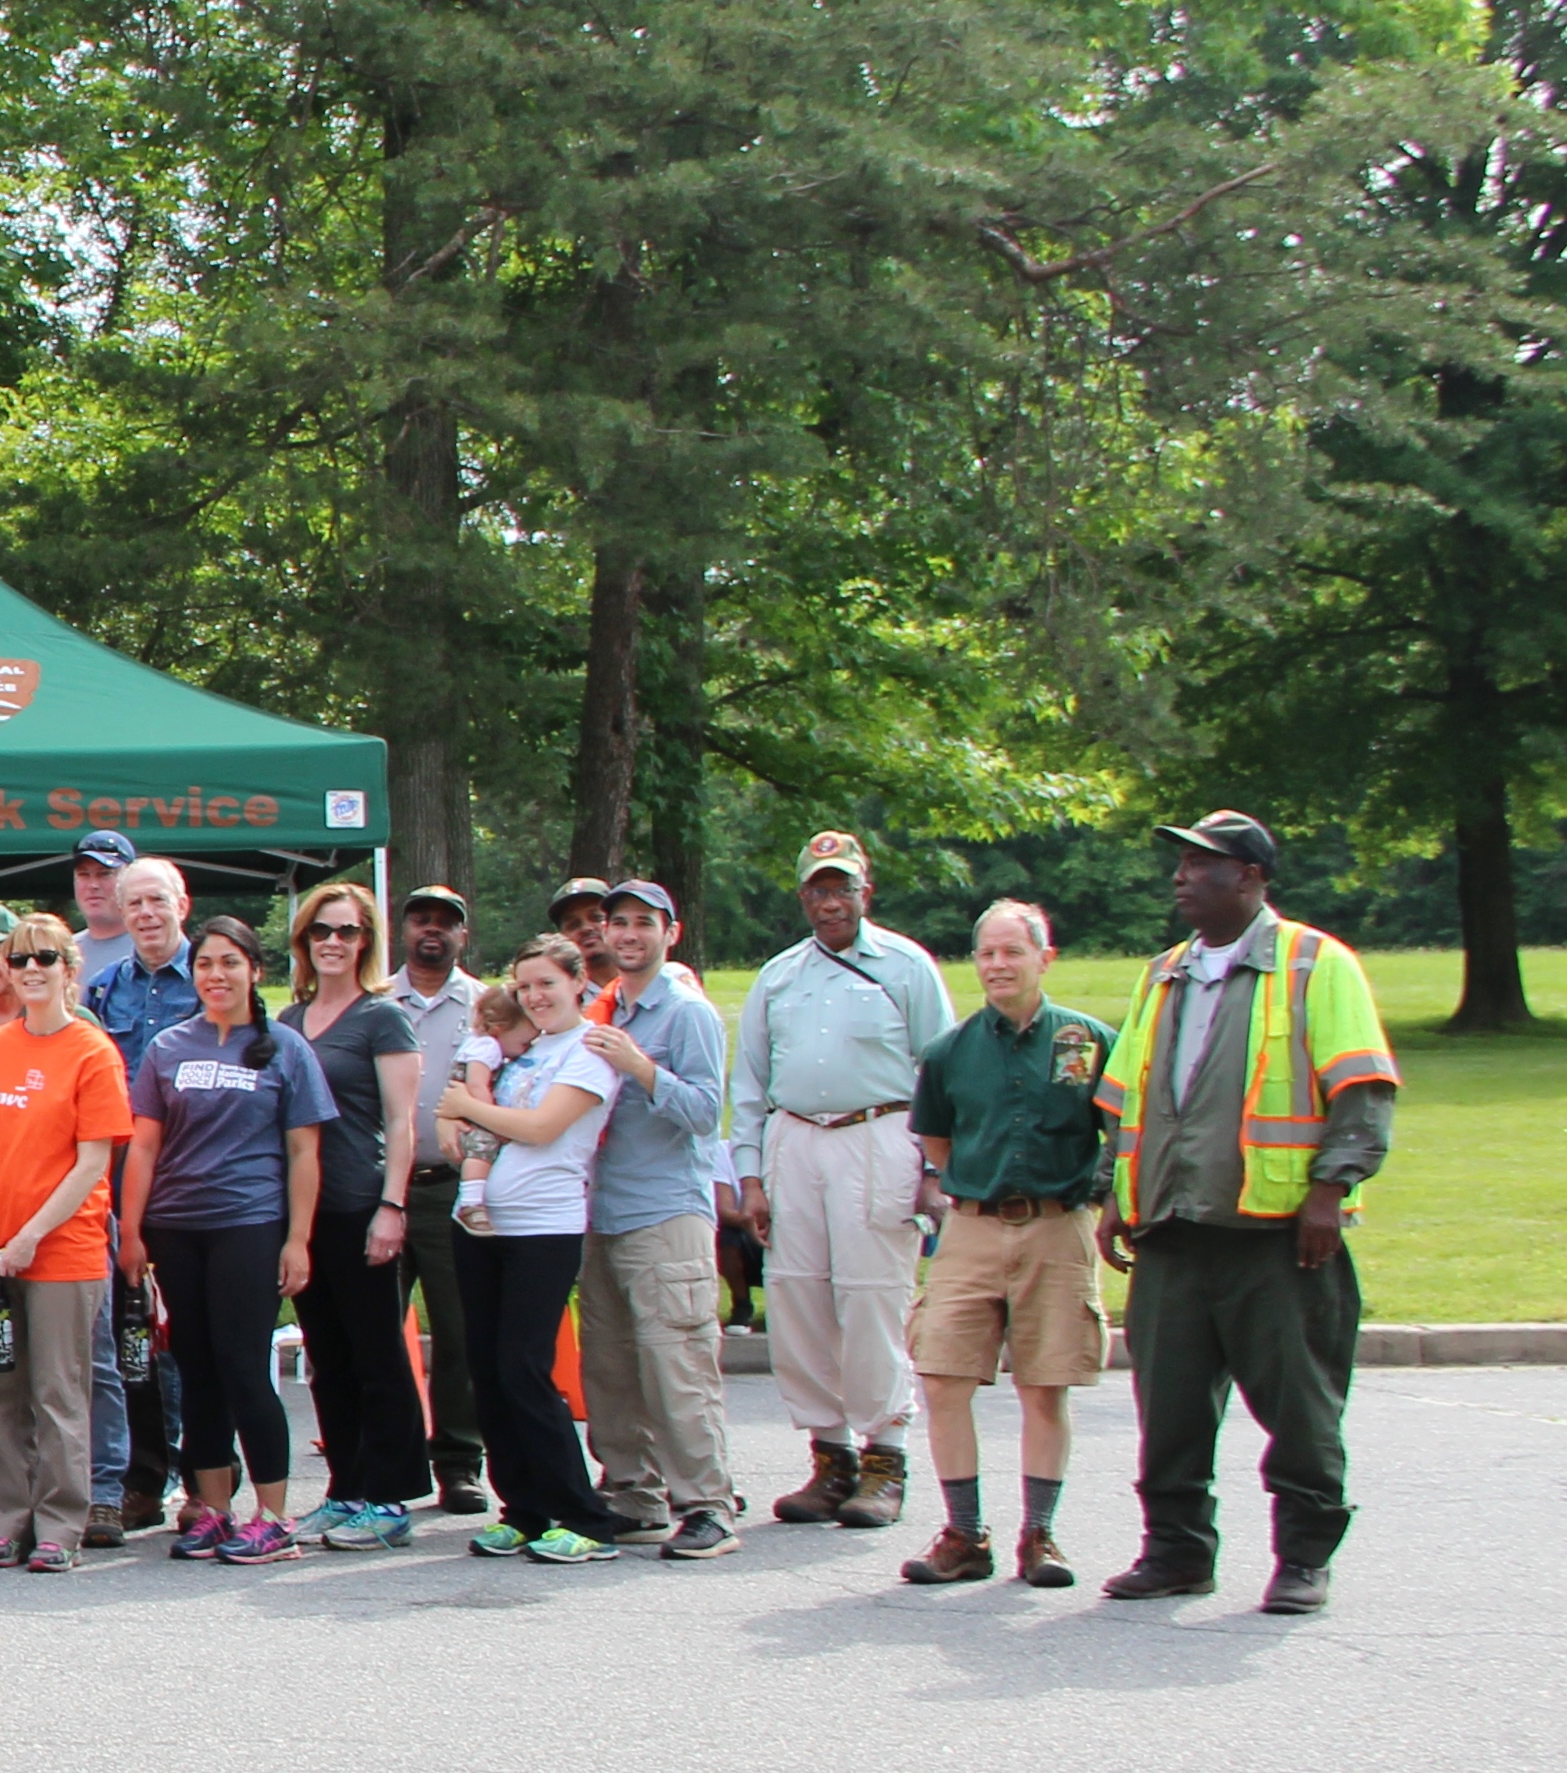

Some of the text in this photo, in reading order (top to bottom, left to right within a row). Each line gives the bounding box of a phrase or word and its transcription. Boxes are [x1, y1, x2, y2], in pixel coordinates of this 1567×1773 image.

[45, 785, 280, 830] Service
[182, 1064, 214, 1072] FIND
[180, 1071, 212, 1079] YOUR
[177, 1078, 210, 1086] VOICE
[215, 1077, 256, 1092] Parks
